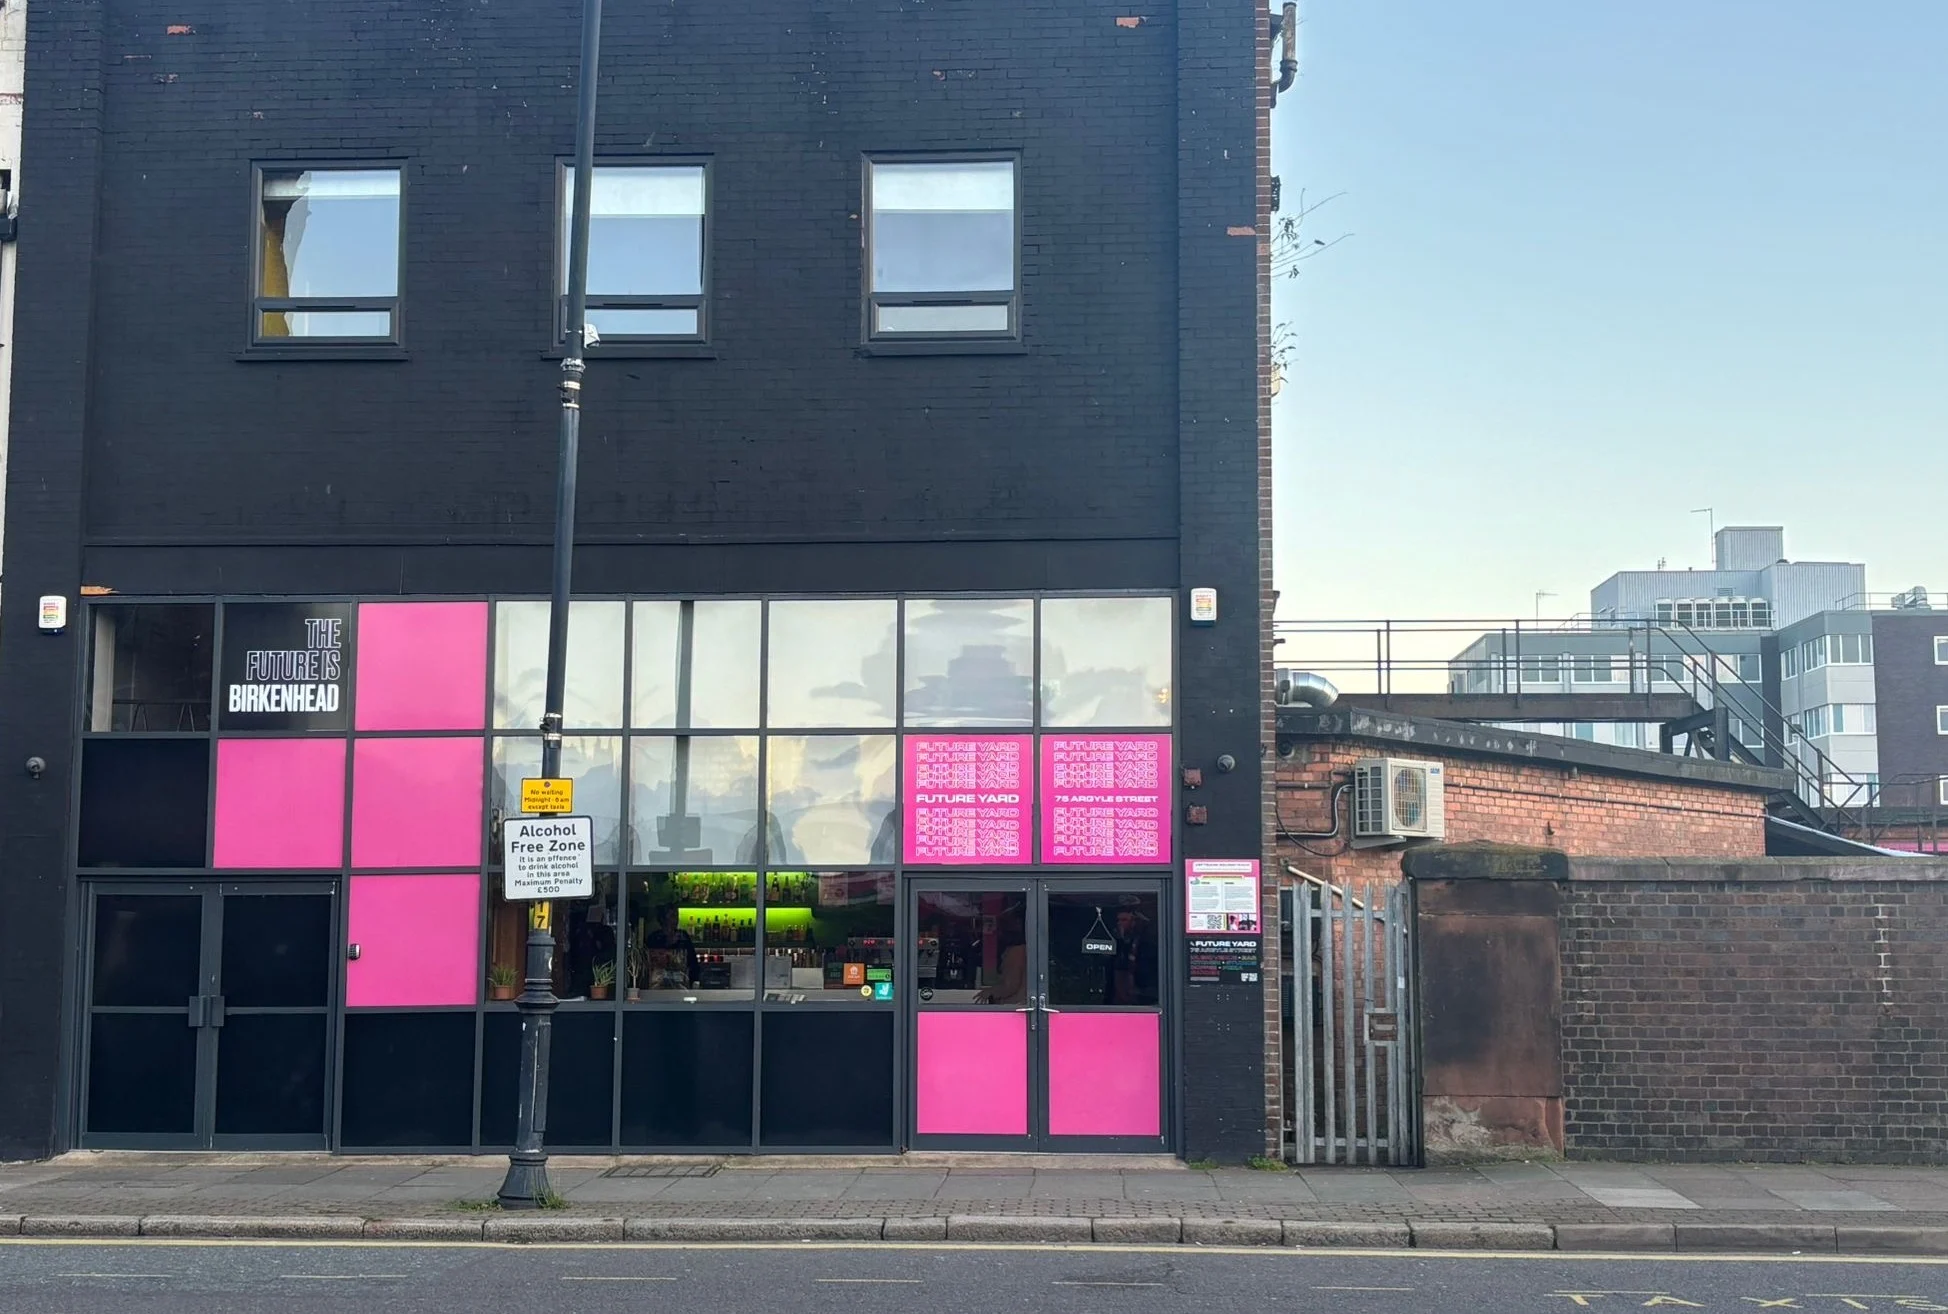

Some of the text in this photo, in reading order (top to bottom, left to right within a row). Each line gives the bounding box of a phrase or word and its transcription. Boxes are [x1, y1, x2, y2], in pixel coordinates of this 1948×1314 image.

[305, 619, 342, 648] THE
[246, 650, 341, 680] FUTURE IS
[229, 684, 339, 712] BIRKENHEAD
[916, 742, 1020, 751] FUTURE YARD
[1054, 742, 1158, 751] FUTURE YARD
[916, 752, 1020, 761] FUTURE YARD
[1054, 752, 1158, 761] FUTURE YARD
[916, 794, 1020, 803] FUTURE YARD
[916, 808, 1020, 817] FUTURE YARD
[1054, 808, 1158, 817] FUTURE YARD
[520, 824, 576, 837] Alcohol
[511, 840, 586, 853] Free Zone
